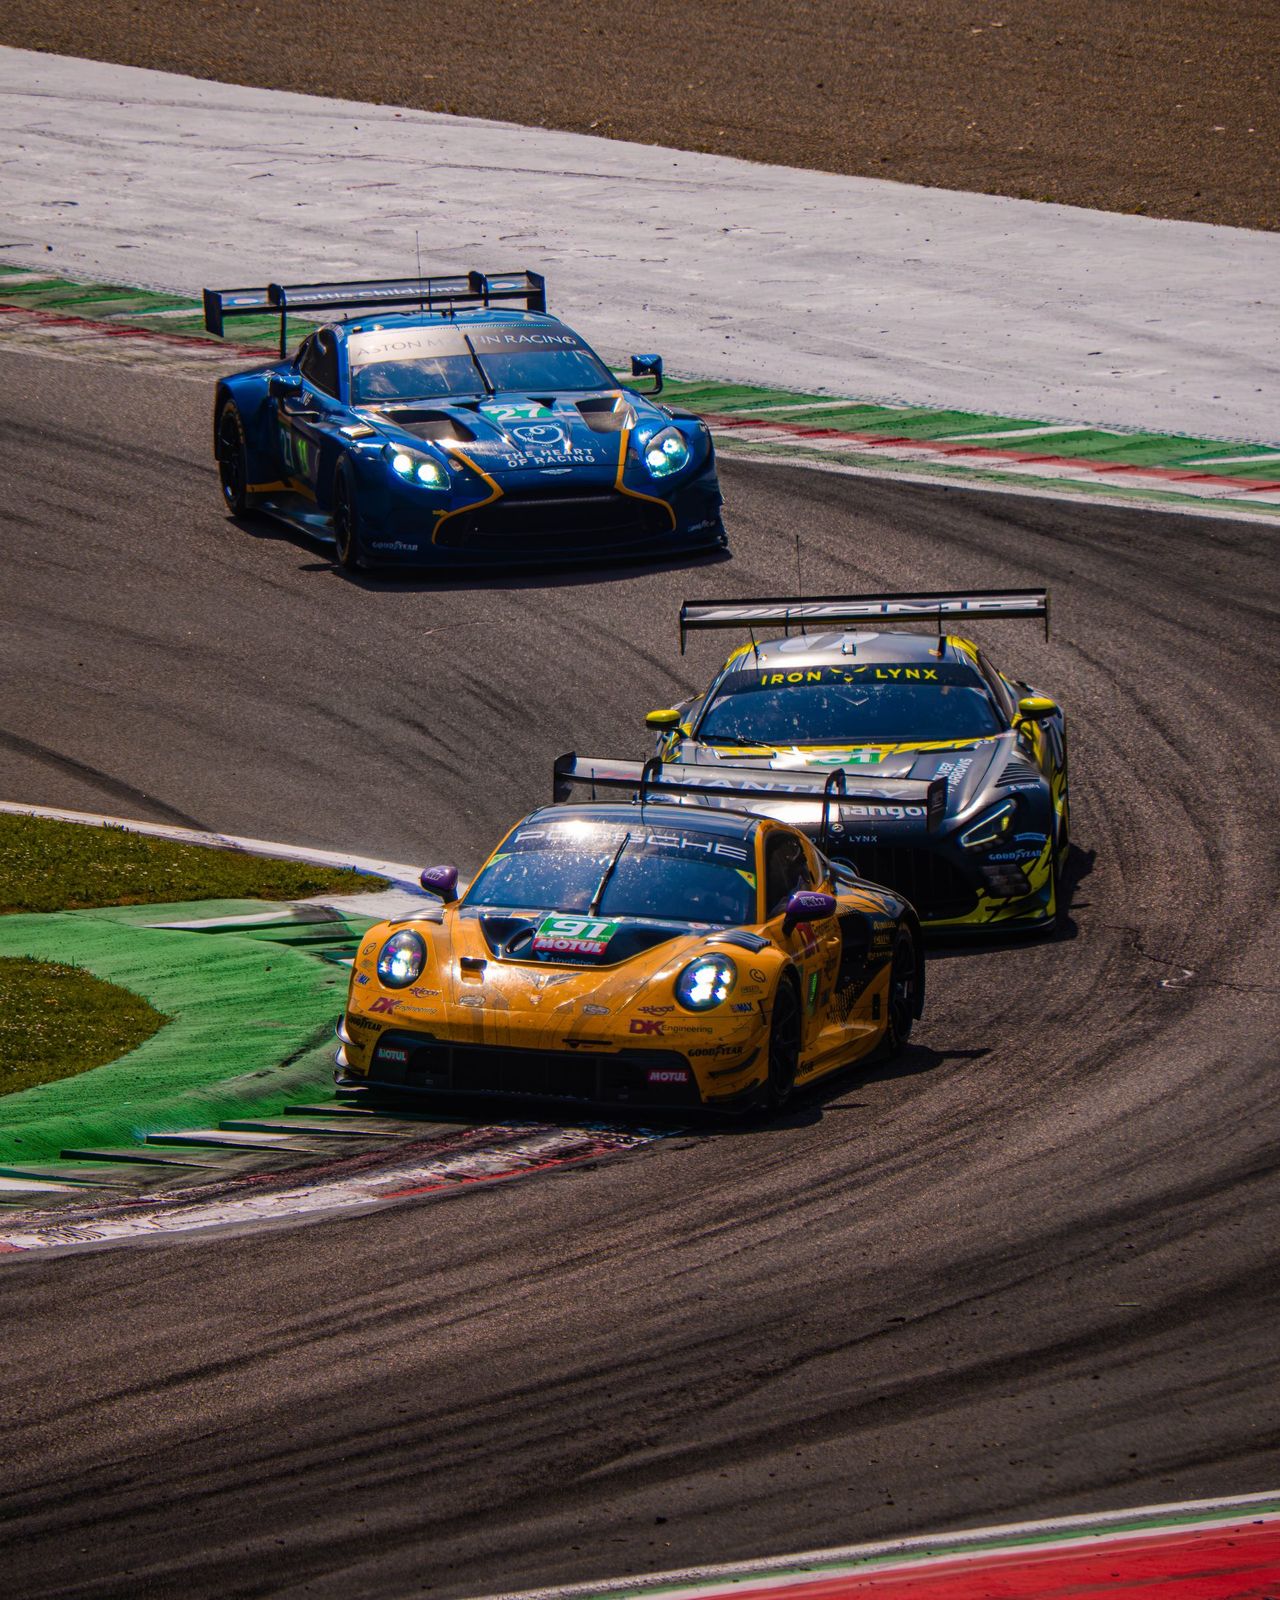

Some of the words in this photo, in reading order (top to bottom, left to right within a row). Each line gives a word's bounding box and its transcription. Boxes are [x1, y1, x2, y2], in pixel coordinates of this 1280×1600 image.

[357, 340, 422, 356] ASTON
[505, 333, 576, 346] RACING
[490, 406, 542, 421] 27
[501, 450, 534, 462] THE
[541, 446, 594, 457] HEART
[507, 458, 529, 468] OF
[534, 454, 596, 466] RACING
[760, 670, 823, 686] IRON
[875, 668, 939, 681] LYNX
[849, 834, 878, 843] LYNX
[552, 919, 611, 939] 91
[534, 939, 603, 954] MOTUL
[367, 996, 404, 1015] DK
[629, 1018, 664, 1036] DK
[662, 1024, 713, 1036] Engineering
[378, 1047, 407, 1061] MOTUL
[687, 1043, 744, 1058] GOODYEAR
[649, 1071, 689, 1082] MOTUL
